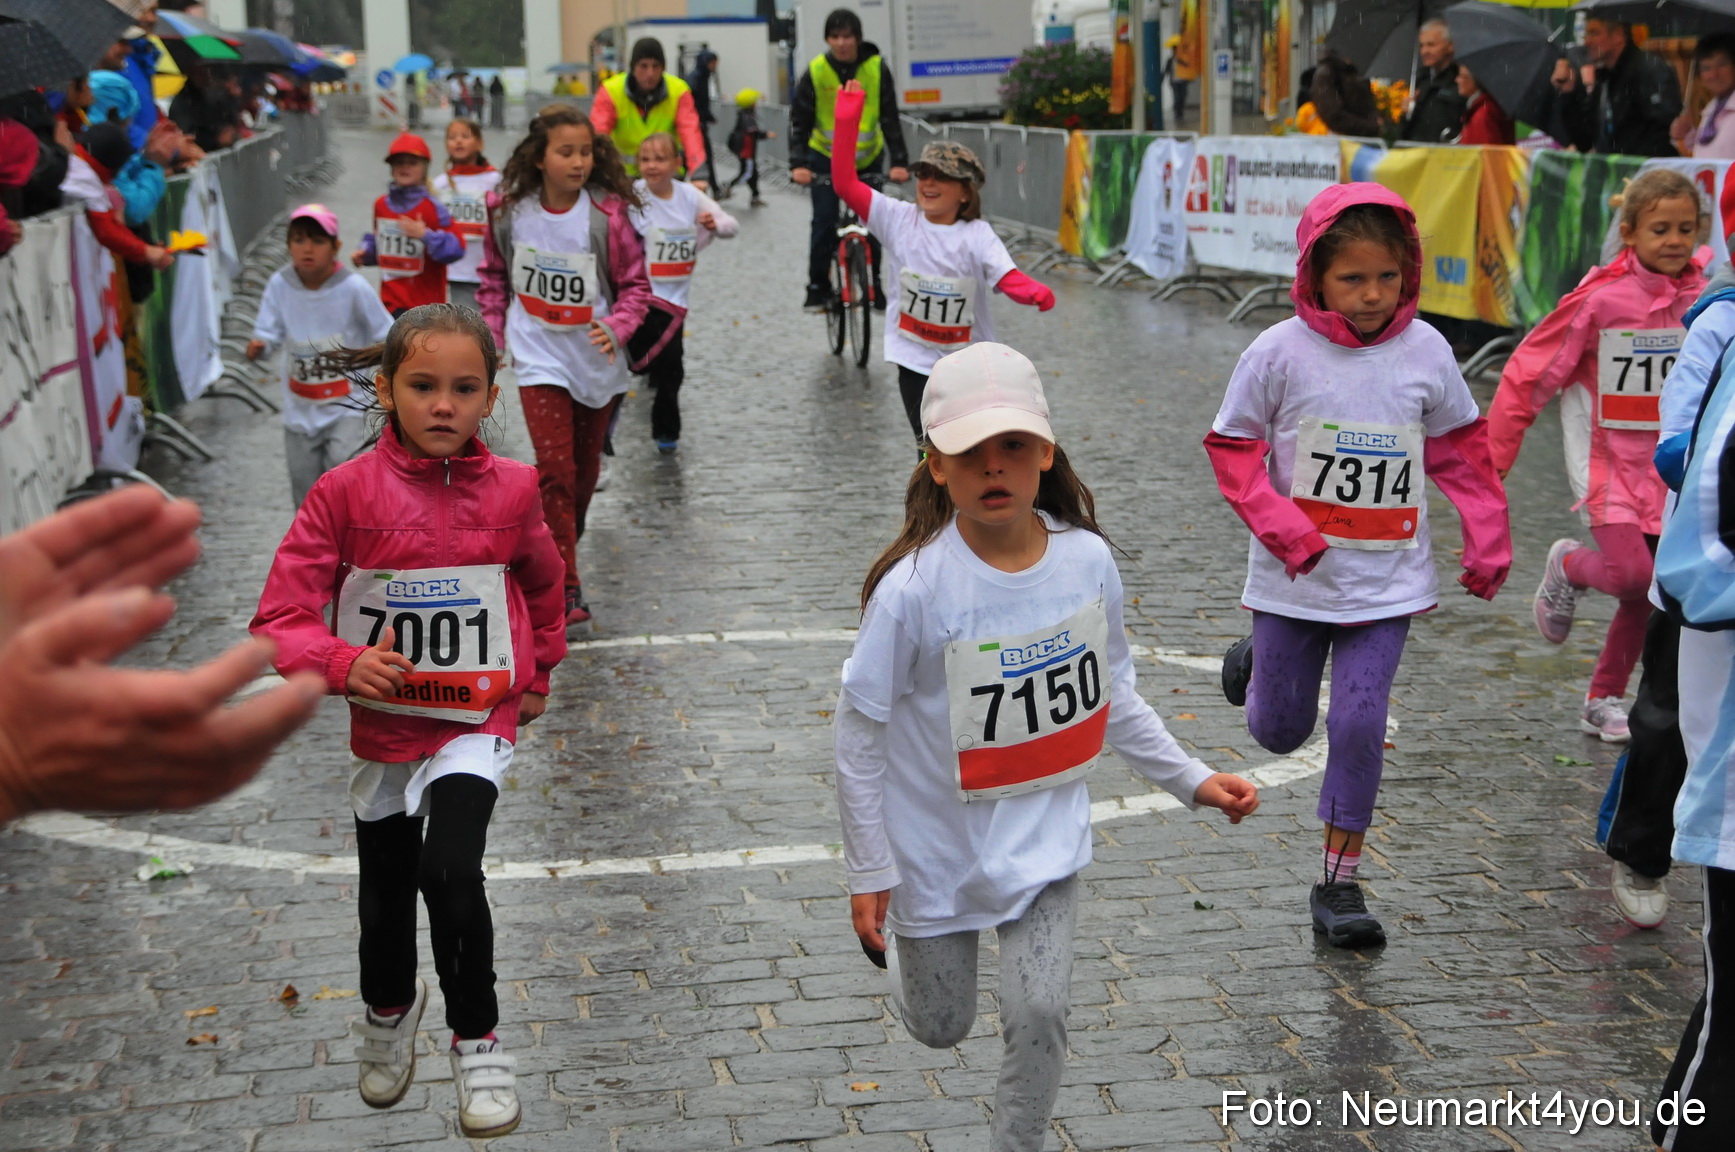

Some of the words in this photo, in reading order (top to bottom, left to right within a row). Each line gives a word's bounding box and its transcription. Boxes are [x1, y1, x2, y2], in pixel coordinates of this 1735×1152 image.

[380, 234, 416, 257] 115
[522, 265, 584, 304] 7099
[907, 289, 966, 324] 7117
[1612, 355, 1678, 392] 719
[1336, 431, 1397, 448] BOCK
[1311, 451, 1412, 504] 7314
[386, 578, 461, 598] BOCK
[359, 605, 489, 667] 7001
[1000, 630, 1071, 667] BOCK
[970, 650, 1101, 742] 7150
